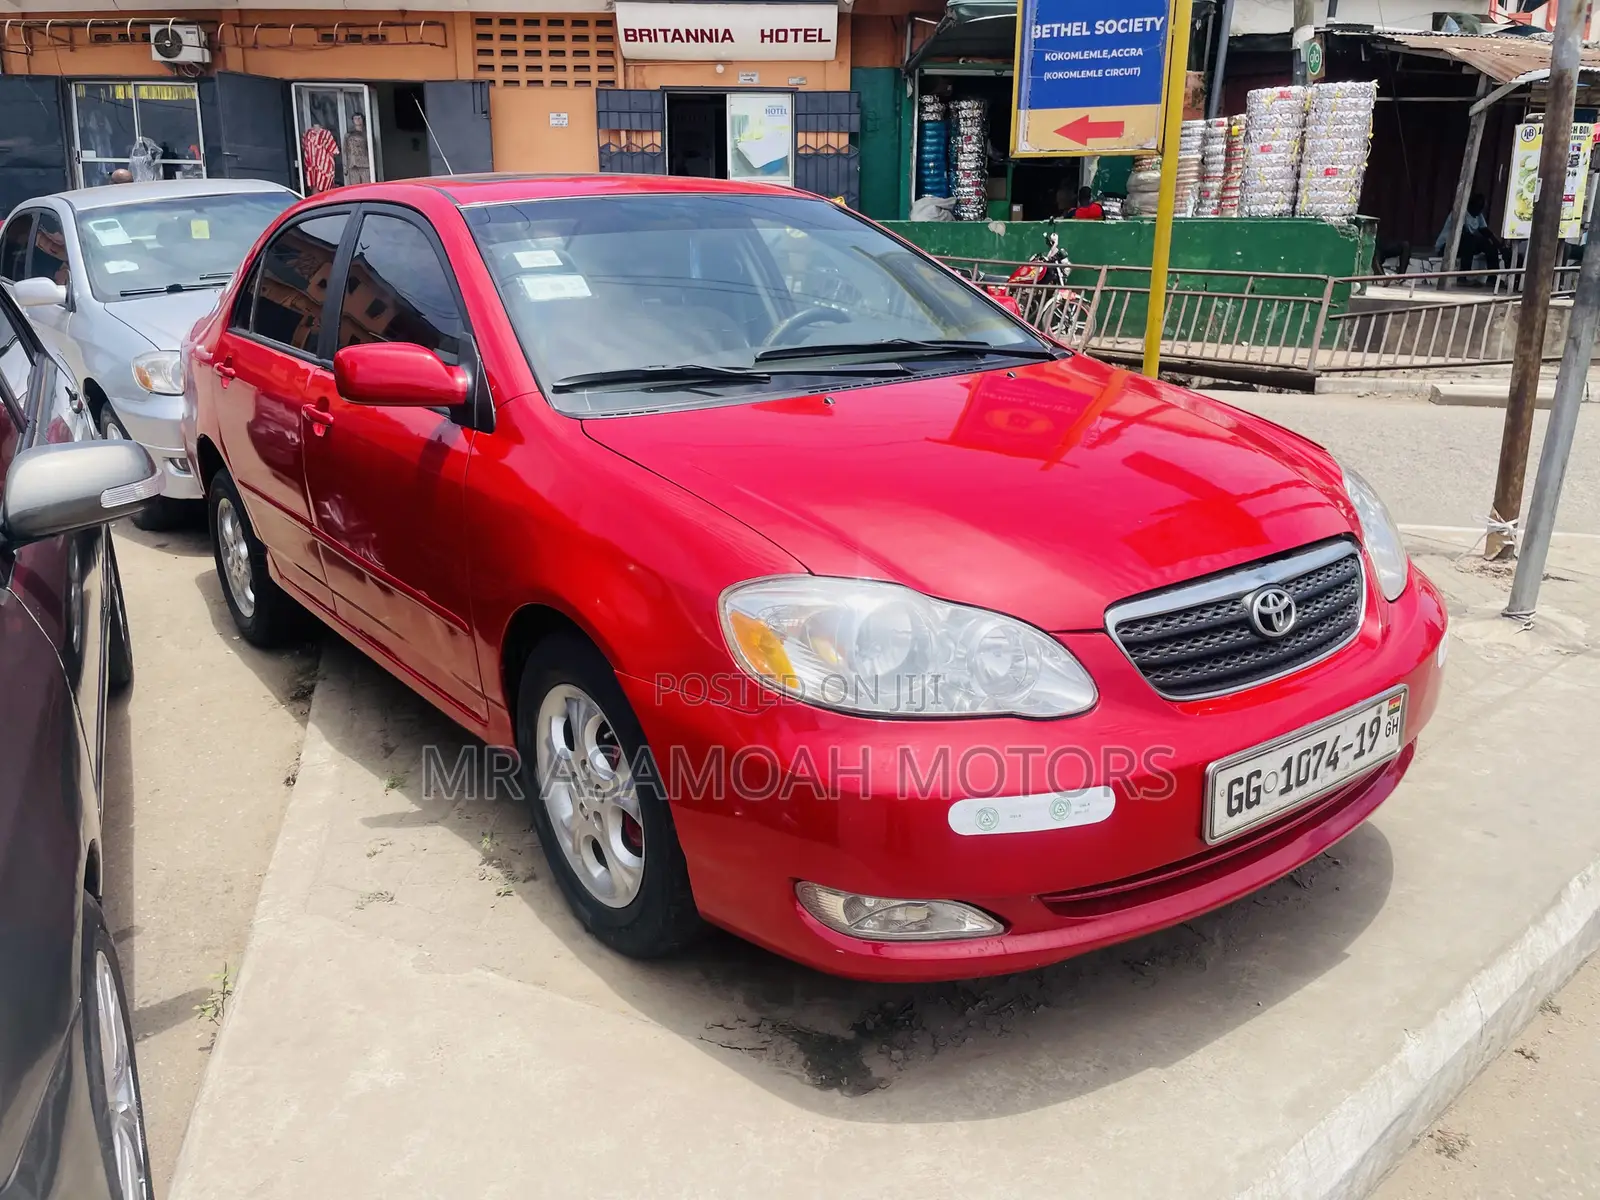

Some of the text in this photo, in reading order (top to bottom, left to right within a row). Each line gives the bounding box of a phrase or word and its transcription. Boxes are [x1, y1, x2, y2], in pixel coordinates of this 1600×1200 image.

[623, 27, 831, 44] BRITANNIA HOTEL
[1031, 16, 1165, 39] BETHEL SOCIETY
[1309, 50, 1320, 67] glo
[1043, 66, 1141, 82] (KOKOMLEMLE CIRCUIT)
[1385, 717, 1399, 738] GH
[1226, 715, 1381, 818] GG 1074-19
